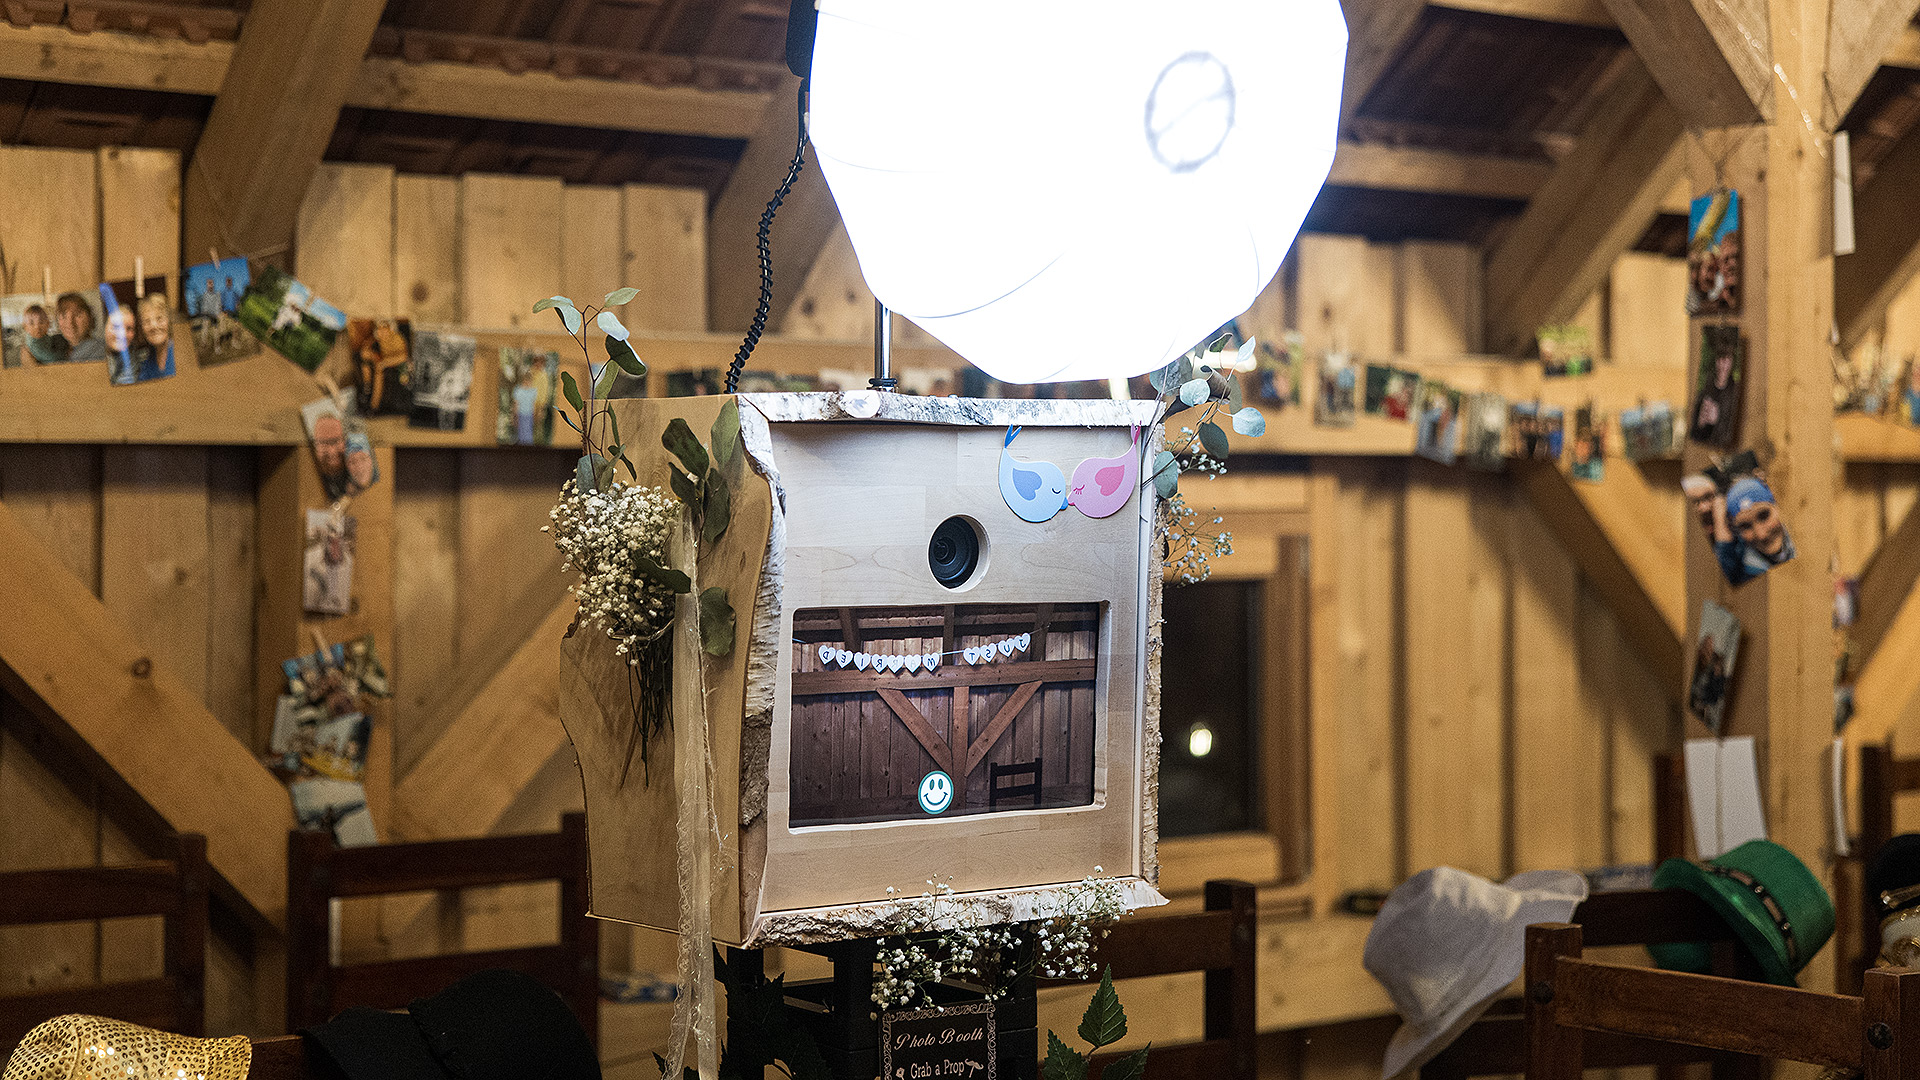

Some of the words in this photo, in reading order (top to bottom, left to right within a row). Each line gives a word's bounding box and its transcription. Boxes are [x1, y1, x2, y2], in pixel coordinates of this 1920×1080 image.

[894, 1033, 936, 1050] Photo
[939, 1027, 984, 1045] Booth
[910, 1061, 932, 1079] Grab
[935, 1065, 941, 1076] a
[944, 1059, 965, 1077] Prop
